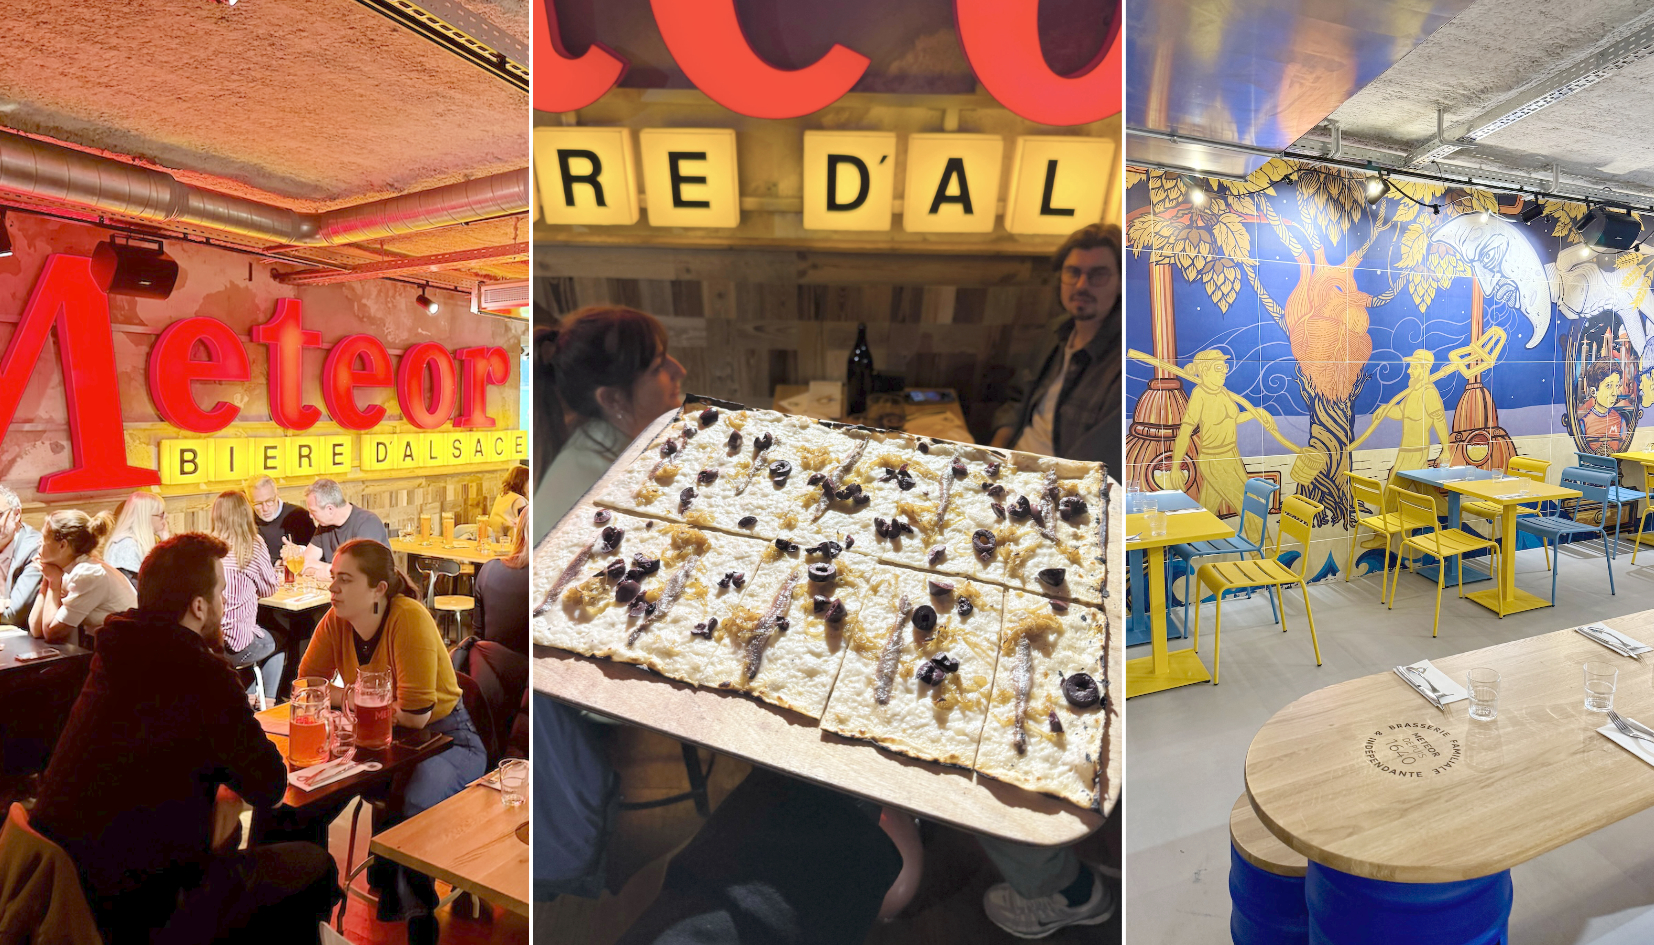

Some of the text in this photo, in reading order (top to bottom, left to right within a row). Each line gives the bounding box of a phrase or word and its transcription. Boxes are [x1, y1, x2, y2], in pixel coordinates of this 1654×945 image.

[179, 435, 523, 476] BIERE D'ALSACE
[1388, 722, 1451, 738] BRASSERIE
[1364, 737, 1423, 778] INDÉPENDANTE
[1385, 738, 1417, 765] 1640
[1401, 737, 1428, 759] DEPUIS
[1411, 732, 1441, 758] METEOR
[1431, 739, 1462, 775] FAMILIALE
